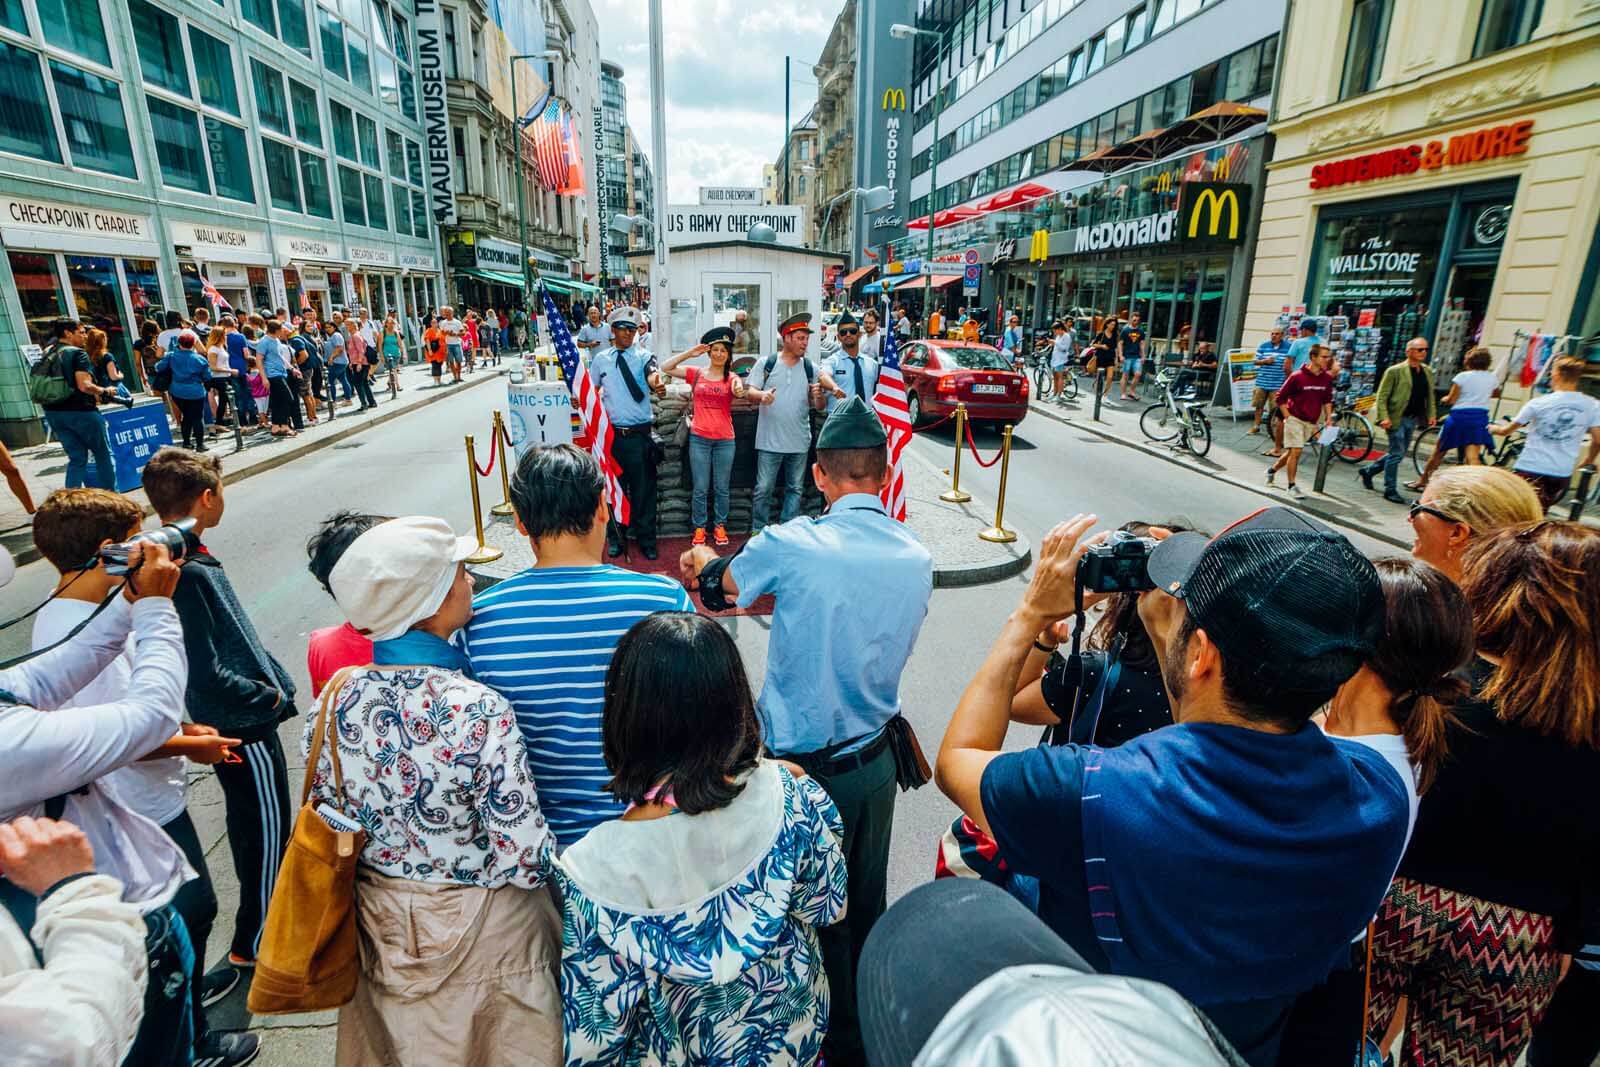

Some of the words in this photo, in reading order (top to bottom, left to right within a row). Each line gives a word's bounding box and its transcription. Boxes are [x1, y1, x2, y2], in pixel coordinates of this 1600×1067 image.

[417, 29, 453, 218] MAUERMUSEUM
[593, 106, 604, 150] CHARLIE
[1420, 141, 1443, 170] &
[1442, 120, 1535, 165] MORE
[707, 190, 724, 200] ALLIED
[725, 190, 756, 200] CHECKPOINT
[9, 202, 91, 229] CHECKPOINT
[94, 214, 140, 235] CHARLIE
[667, 214, 684, 232] US
[689, 214, 722, 232] ARMY
[727, 214, 797, 233] CHECPOINT
[194, 228, 218, 244] WALL
[217, 231, 248, 247] MUSEUM
[1329, 252, 1421, 275] WALLSTORE
[116, 431, 133, 445] LIFE
[134, 427, 143, 441] IN
[144, 424, 158, 438] THE
[134, 443, 150, 457] GDR
